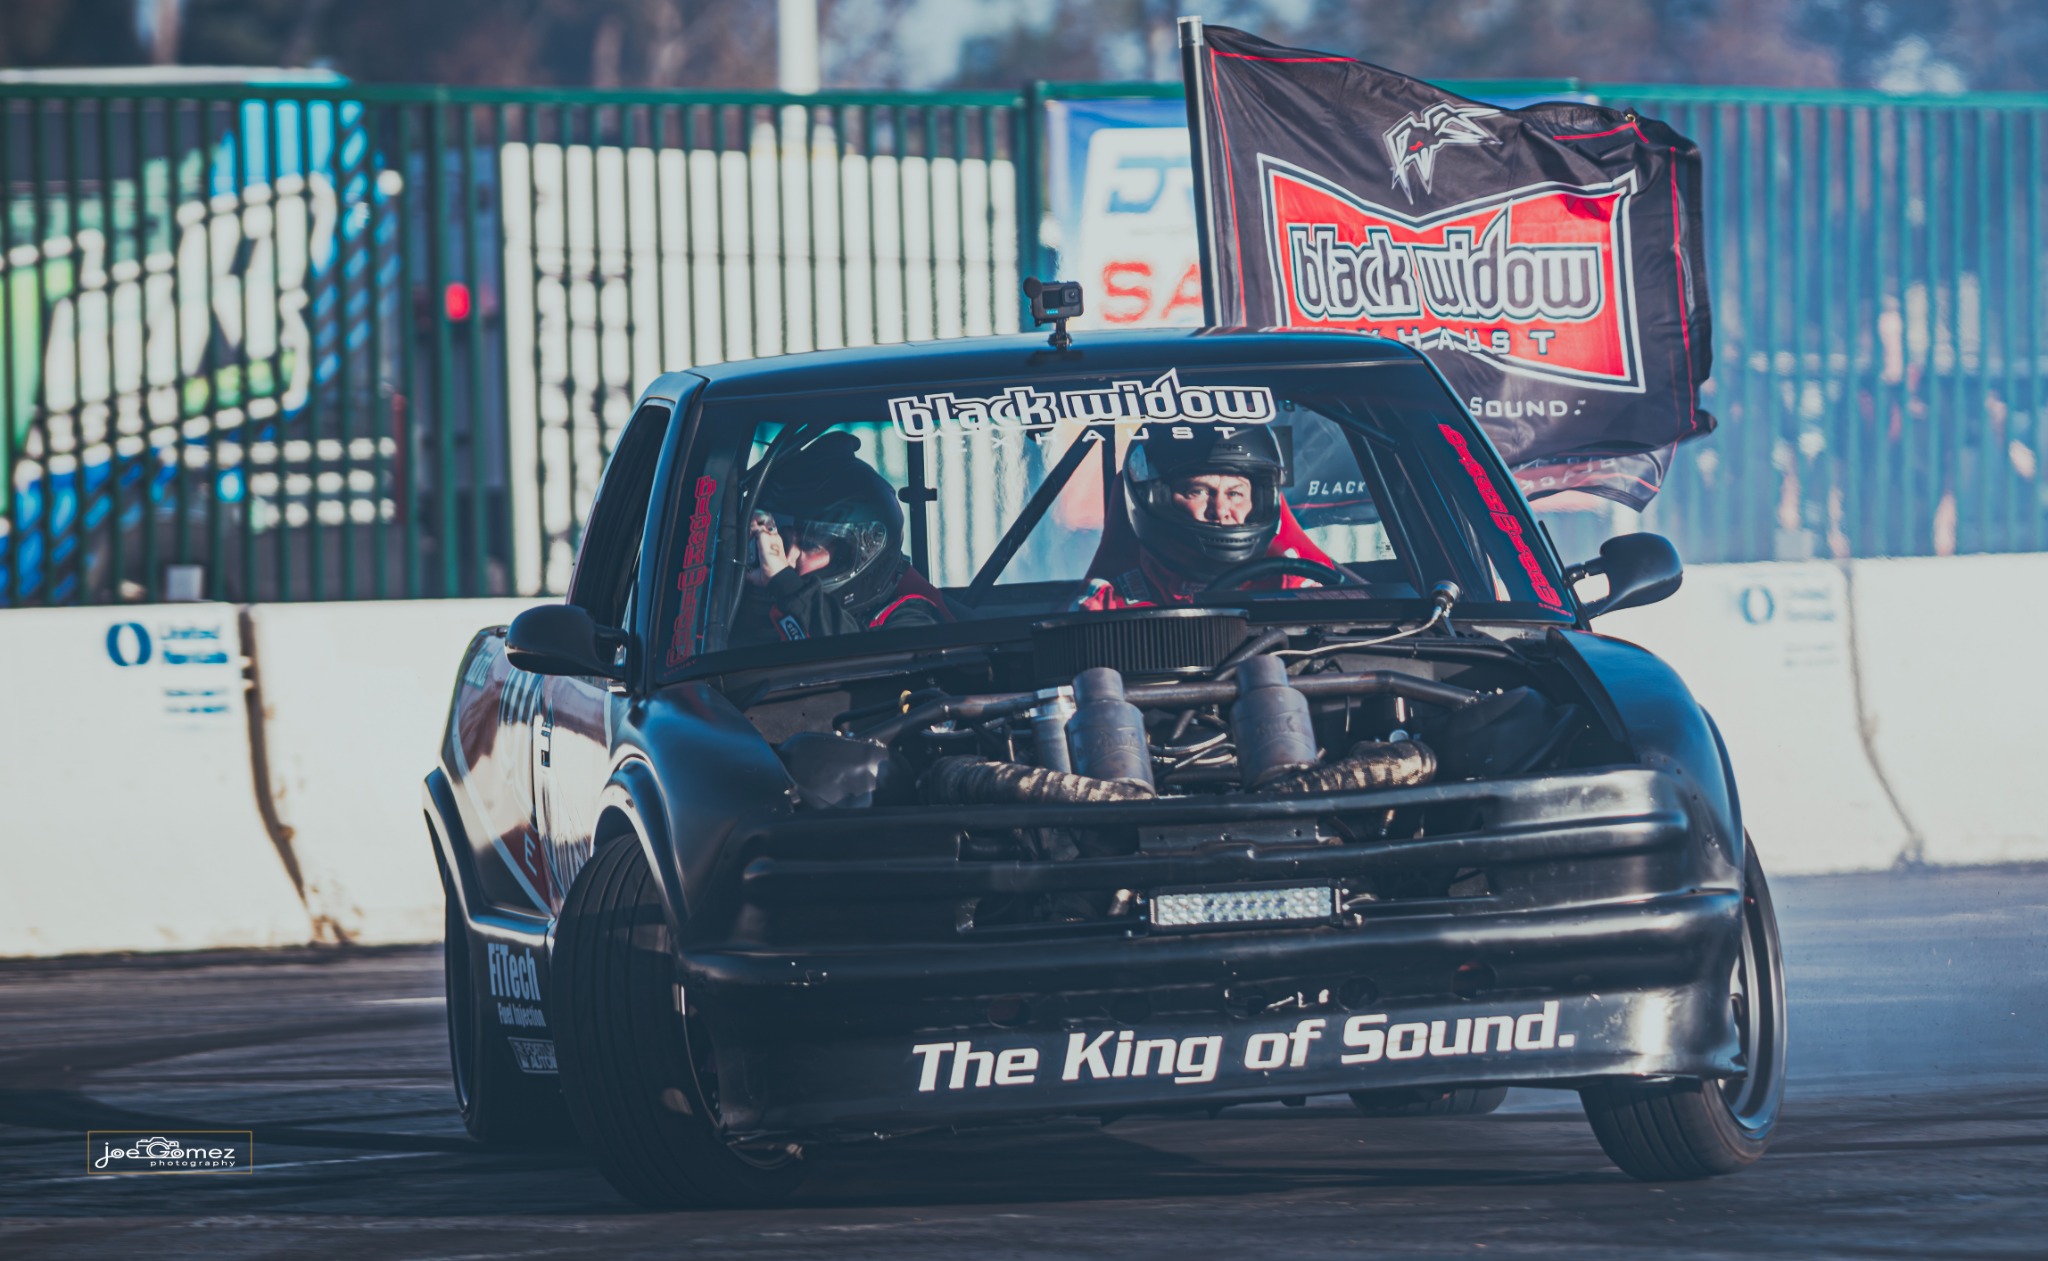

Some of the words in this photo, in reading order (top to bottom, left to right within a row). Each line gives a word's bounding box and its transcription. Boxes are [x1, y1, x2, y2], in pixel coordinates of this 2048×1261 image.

[1287, 223, 1424, 322] black
[1409, 198, 1606, 323] widow
[888, 386, 1061, 441] black
[1060, 367, 1276, 425] widow
[1308, 480, 1366, 496] BLACK
[487, 942, 541, 1001] FiTech
[497, 1001, 515, 1025] Fuel
[912, 1040, 1040, 1093] The
[1062, 1030, 1223, 1084] King
[1244, 1018, 1327, 1070] of
[1341, 1000, 1576, 1065] Sound.
